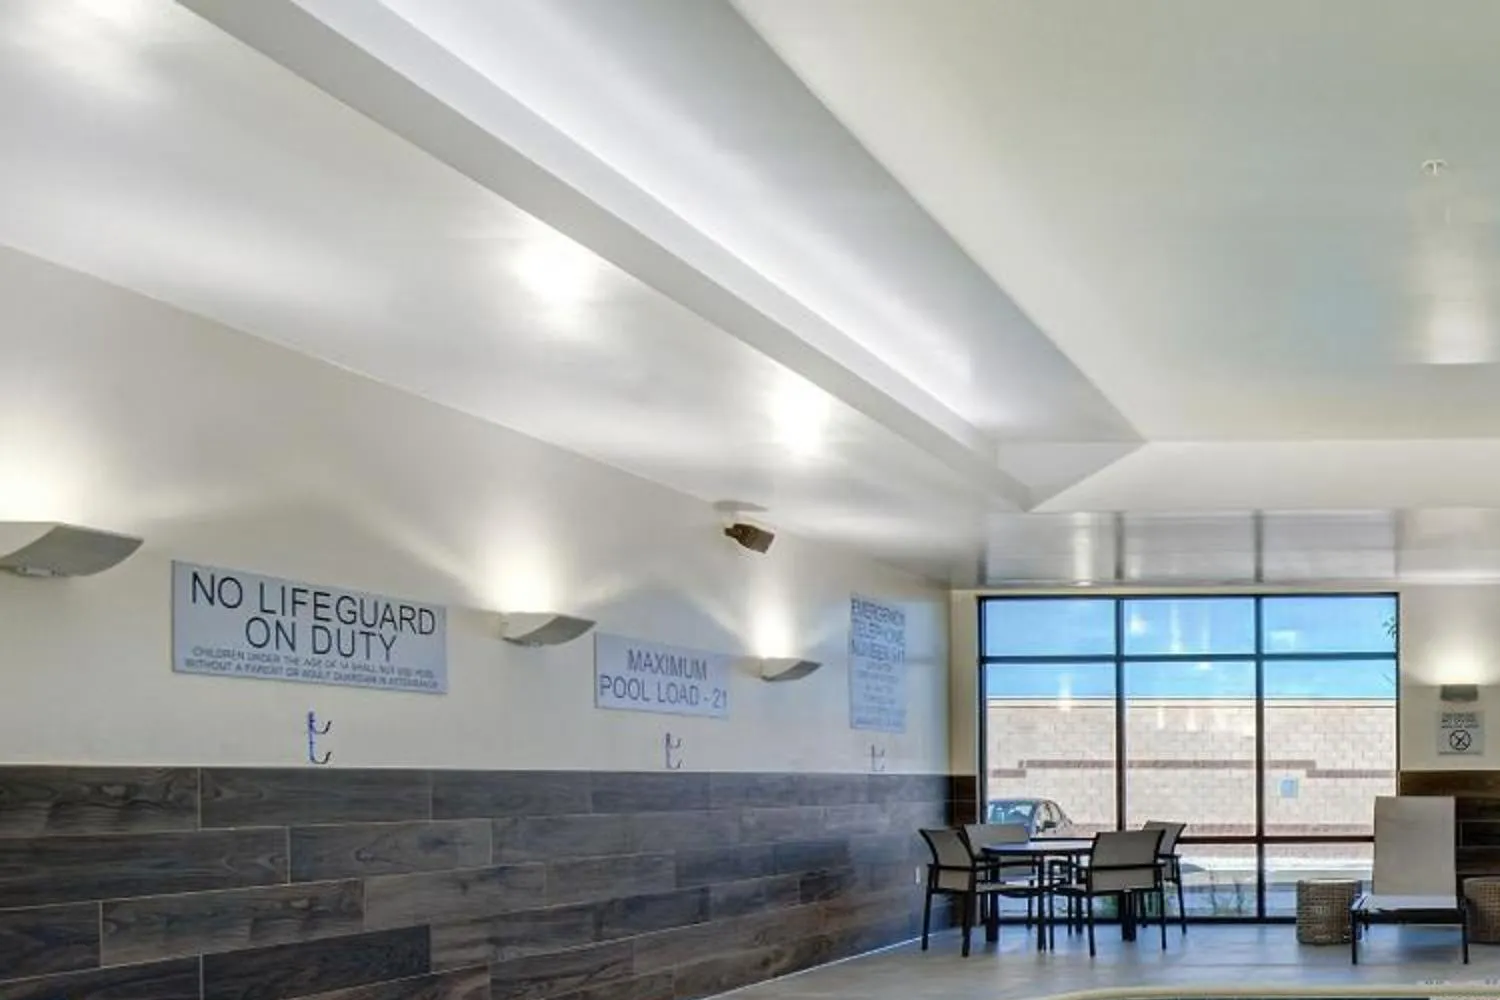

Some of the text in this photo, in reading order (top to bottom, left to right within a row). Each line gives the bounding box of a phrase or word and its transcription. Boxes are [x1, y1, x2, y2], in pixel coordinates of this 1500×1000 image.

[191, 571, 435, 635] NO LIFEGUARD
[245, 617, 397, 662] ON DUTY
[627, 649, 707, 681] MAXIMUM
[600, 674, 650, 701] POOL
[657, 681, 699, 706] LOAD
